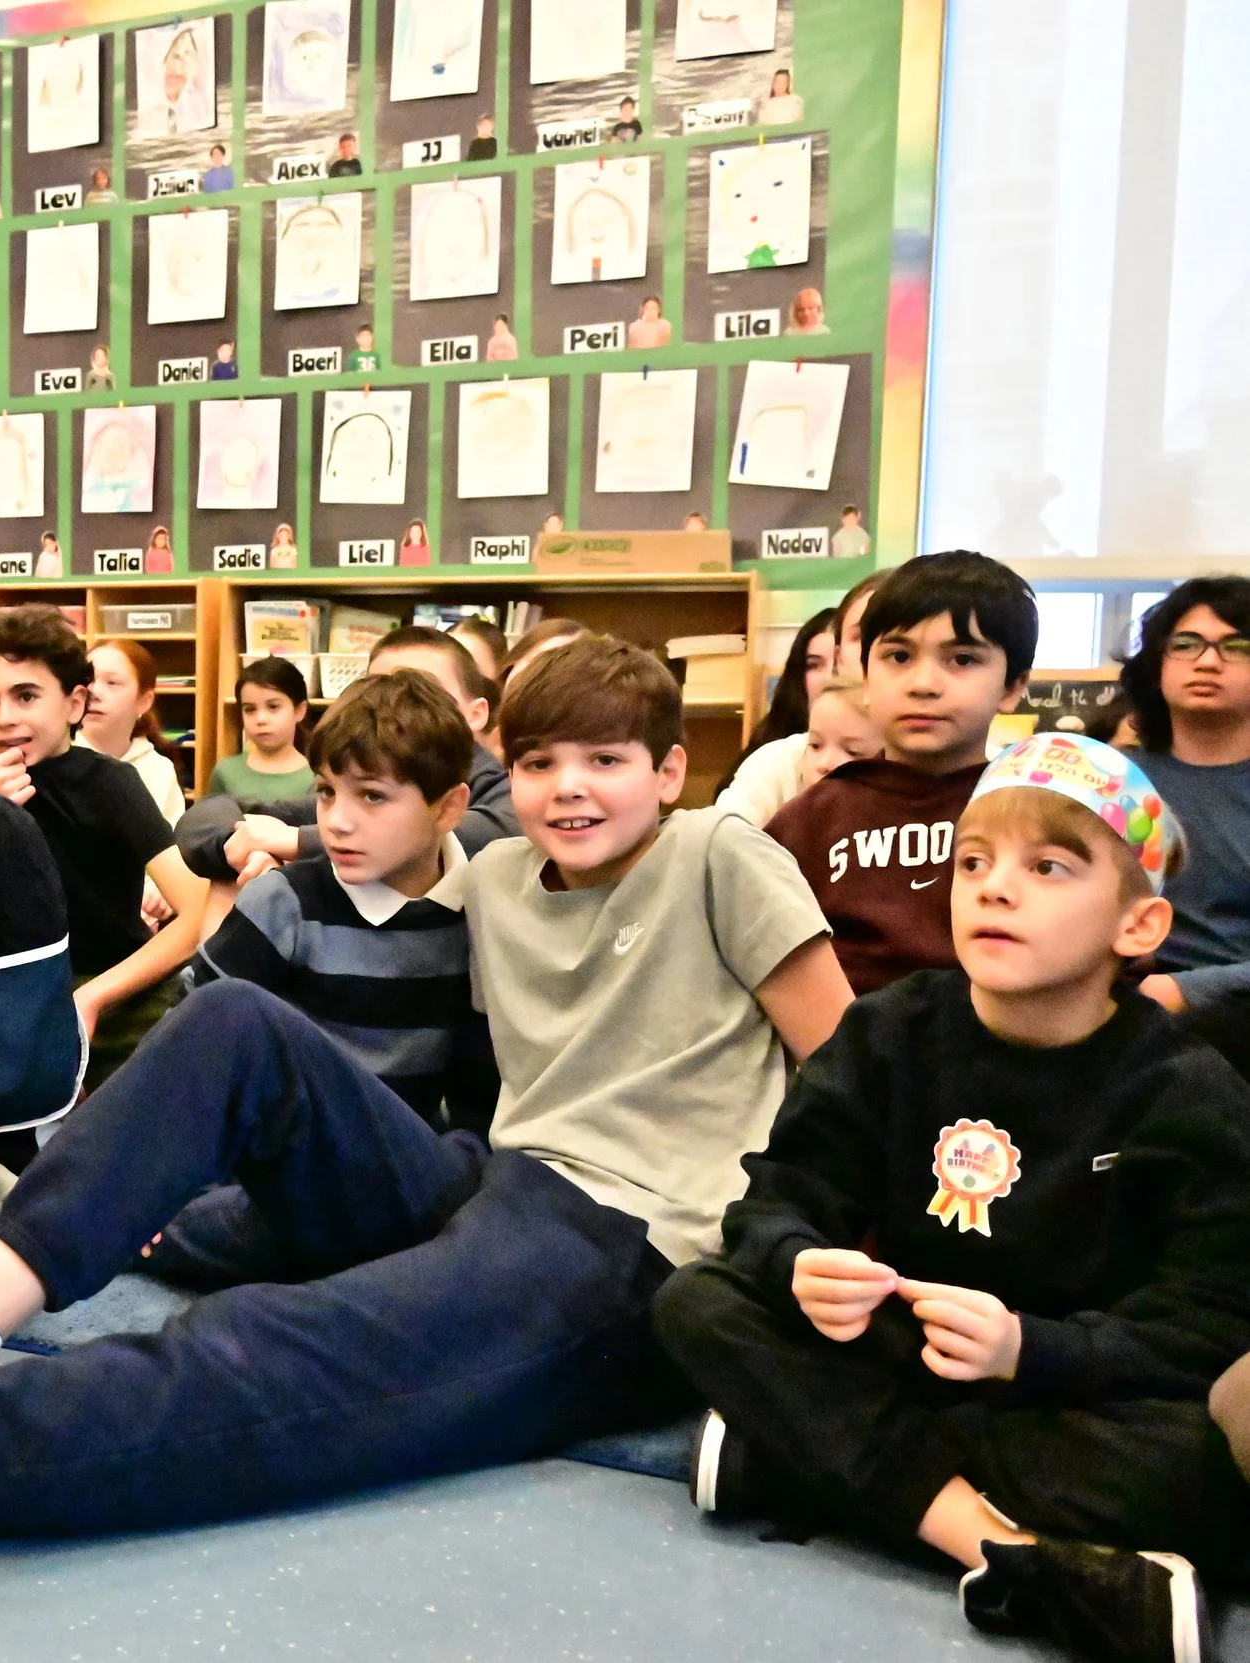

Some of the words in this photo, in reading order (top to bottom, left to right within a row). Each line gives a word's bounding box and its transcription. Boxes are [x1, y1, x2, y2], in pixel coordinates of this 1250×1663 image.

[421, 140, 443, 163] JJ
[277, 161, 321, 181] Alex
[40, 190, 77, 210] Lev
[724, 315, 771, 339] Lila
[570, 326, 619, 351] Peri
[292, 351, 338, 373] Baeri
[429, 341, 472, 363] Ella
[40, 372, 77, 391] Eva
[162, 360, 204, 383] Daniel
[348, 543, 384, 564] Liel
[474, 539, 526, 561] Raphi
[767, 532, 823, 555] Nadav
[98, 552, 140, 572] Talia
[218, 548, 261, 568] Sadie
